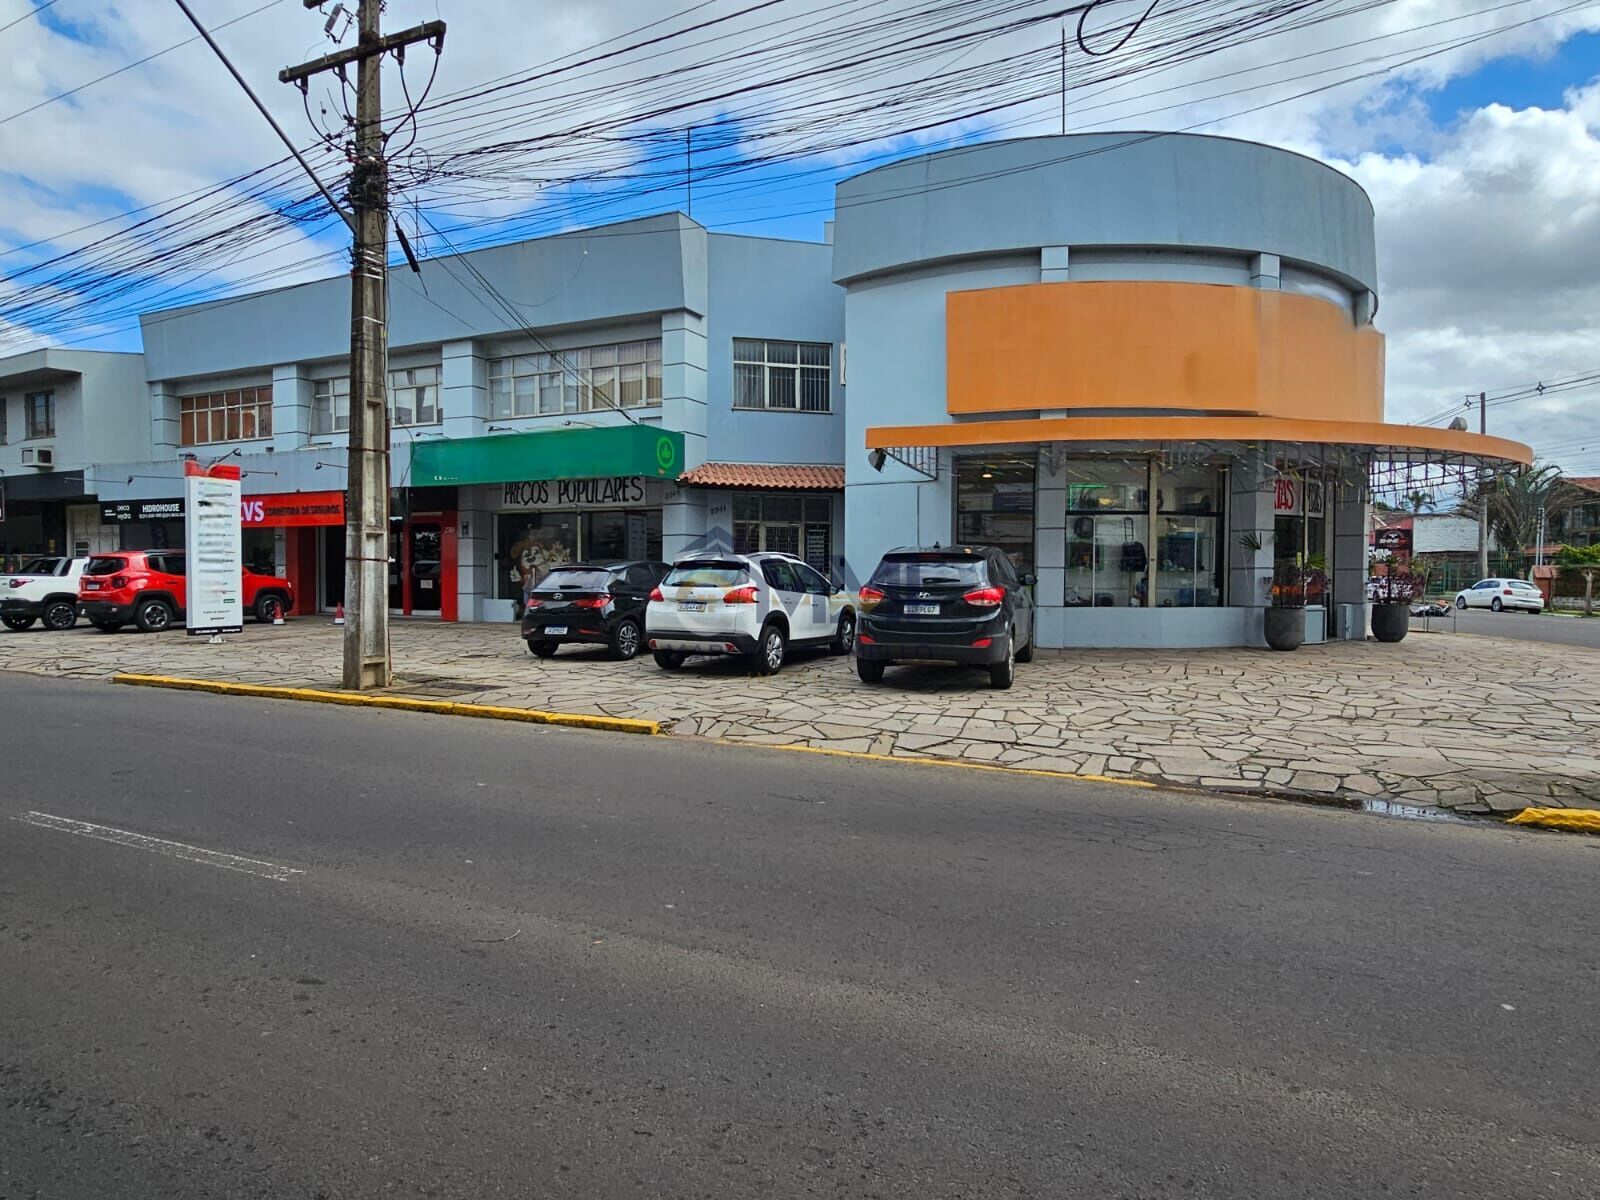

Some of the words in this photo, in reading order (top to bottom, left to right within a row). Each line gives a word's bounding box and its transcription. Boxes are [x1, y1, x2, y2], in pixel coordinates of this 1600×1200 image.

[504, 480, 549, 506] PREÇOS
[558, 476, 644, 504] POPULARES
[142, 503, 180, 513] HIDROHOUSE
